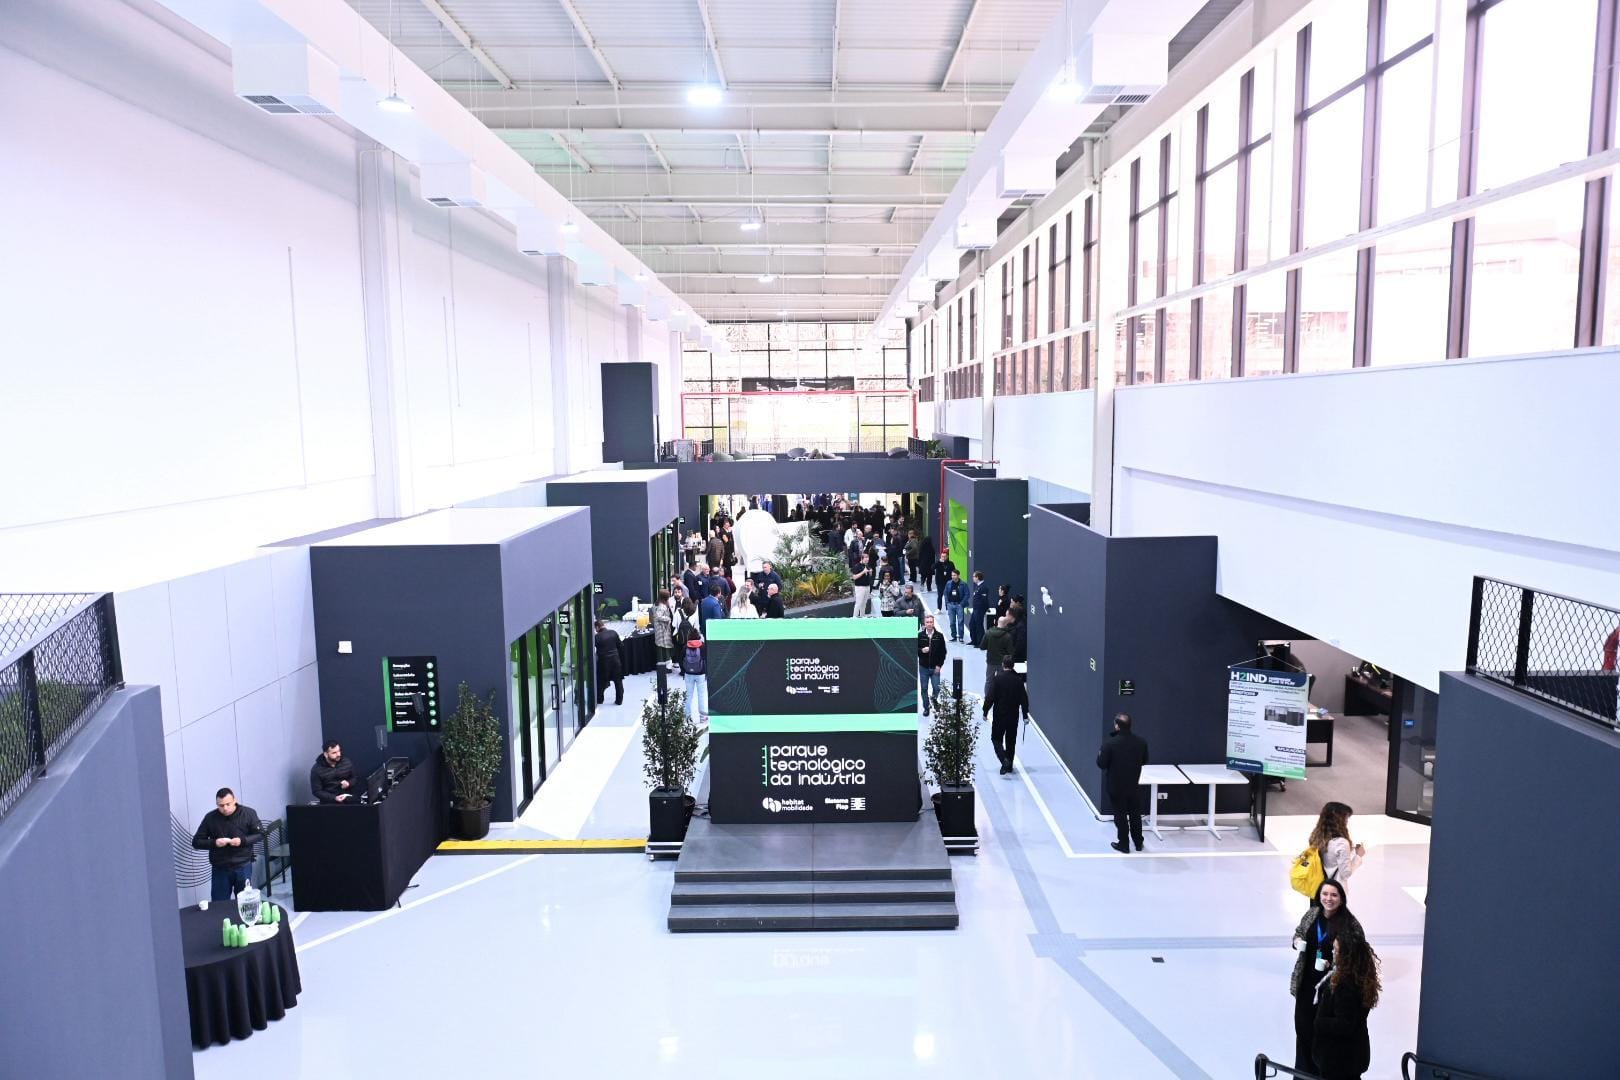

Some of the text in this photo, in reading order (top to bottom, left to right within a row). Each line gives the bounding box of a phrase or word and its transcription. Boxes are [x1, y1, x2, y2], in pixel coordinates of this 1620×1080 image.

[789, 657, 820, 666] parque
[789, 664, 840, 674] tecnológico
[789, 672, 840, 681] da indústria
[1230, 671, 1267, 683] H2IND
[770, 744, 828, 758] parque
[770, 757, 866, 774] tecnológico
[770, 772, 866, 786] da indústria
[781, 798, 804, 806] habitat
[781, 804, 814, 812] mobilidade
